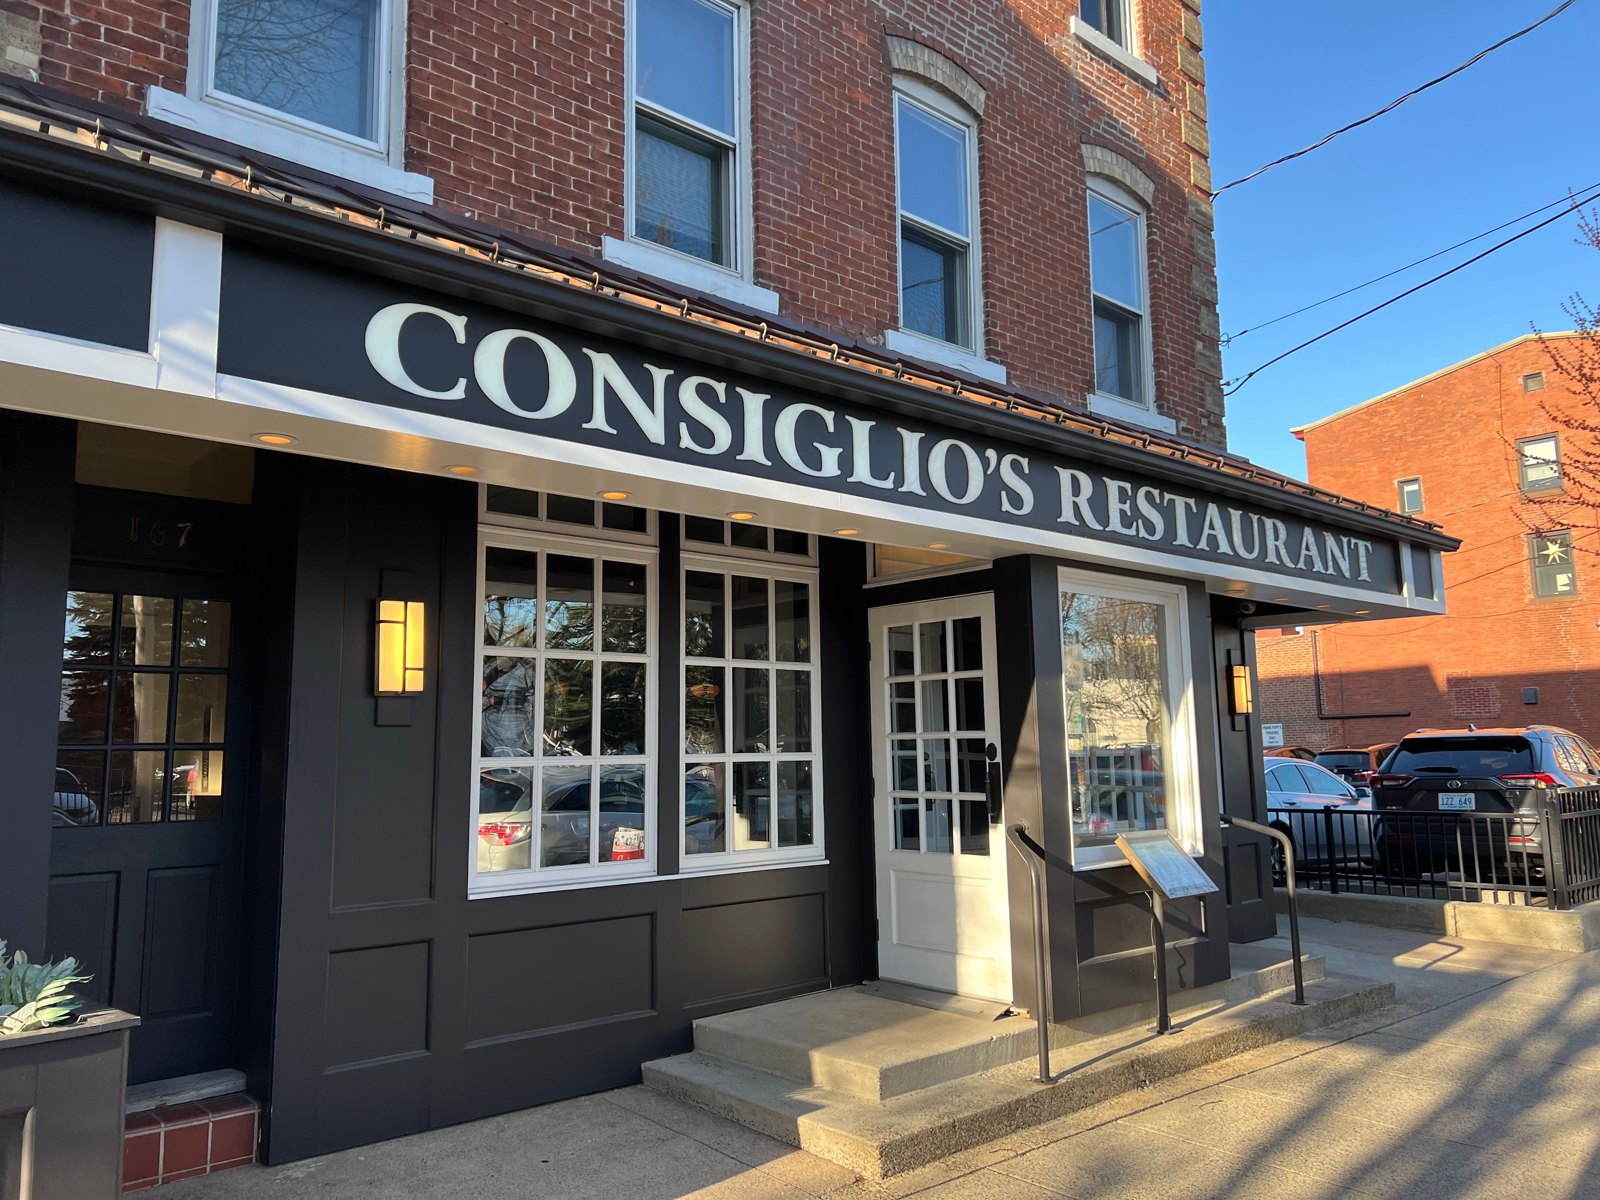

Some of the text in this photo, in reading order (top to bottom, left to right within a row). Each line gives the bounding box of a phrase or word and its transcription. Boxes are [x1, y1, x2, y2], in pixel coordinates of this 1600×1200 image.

[364, 302, 1373, 583] CONSIGLIO'S RESTAURANT
[129, 514, 193, 547] 167
[1458, 797, 1472, 805] 649
